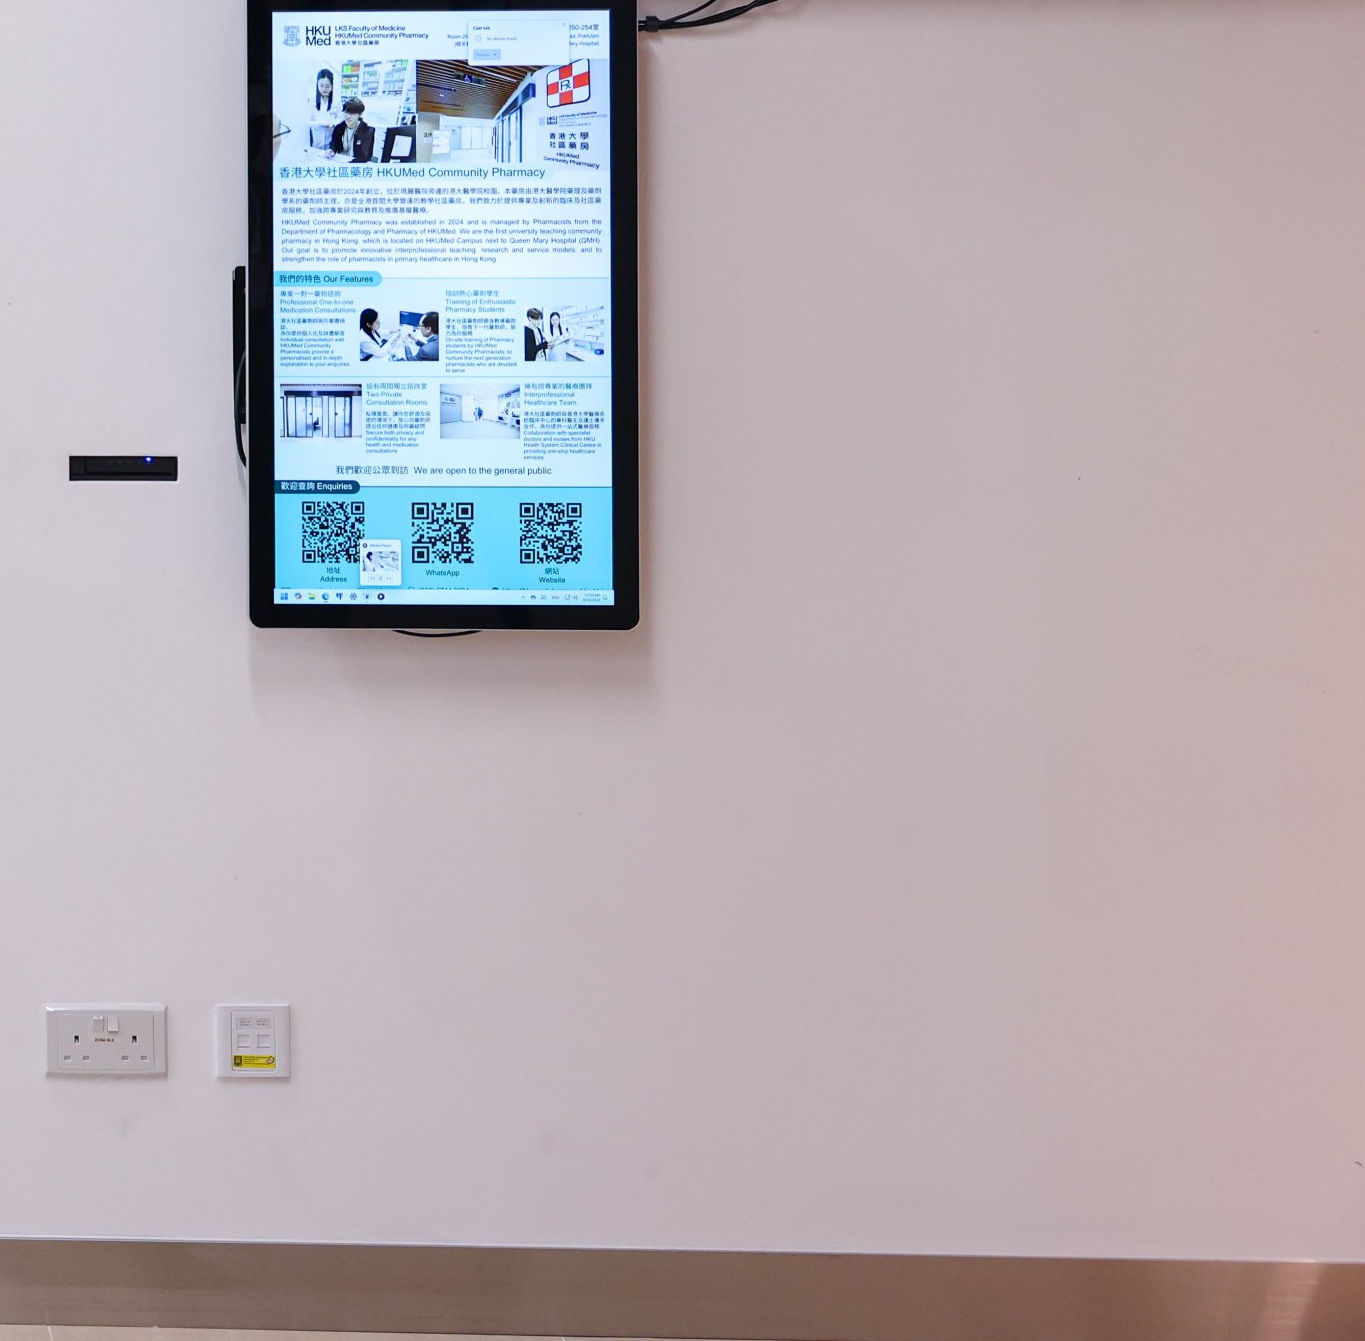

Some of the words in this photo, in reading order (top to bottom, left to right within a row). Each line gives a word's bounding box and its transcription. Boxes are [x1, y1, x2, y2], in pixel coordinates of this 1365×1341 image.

[305, 26, 331, 36] HKU
[305, 36, 331, 46] Med
[550, 132, 589, 140] 香港大學
[550, 142, 589, 150] 社區藥房
[544, 156, 569, 165] Community
[569, 159, 600, 169] Pharmacy
[279, 167, 373, 178] 香港大學社區藥房
[377, 167, 425, 177] HKUMed
[428, 167, 488, 179] Community
[492, 167, 546, 179] Pharmacy
[279, 275, 321, 283] 我們的特色
[323, 275, 338, 283] Our
[340, 275, 373, 283] Features
[336, 465, 409, 475] 我們歡迎公眾到訪
[413, 466, 428, 474] We
[446, 468, 466, 476] open
[479, 466, 491, 474] the
[494, 466, 526, 476] general
[527, 466, 552, 476] public
[281, 482, 315, 490] 歡迎查詢
[317, 482, 353, 491] Enquiries
[326, 567, 341, 575] 地址
[425, 569, 460, 577] WhatsApp
[544, 567, 560, 575] 網站
[320, 575, 348, 583] Address
[539, 575, 566, 584] Website
